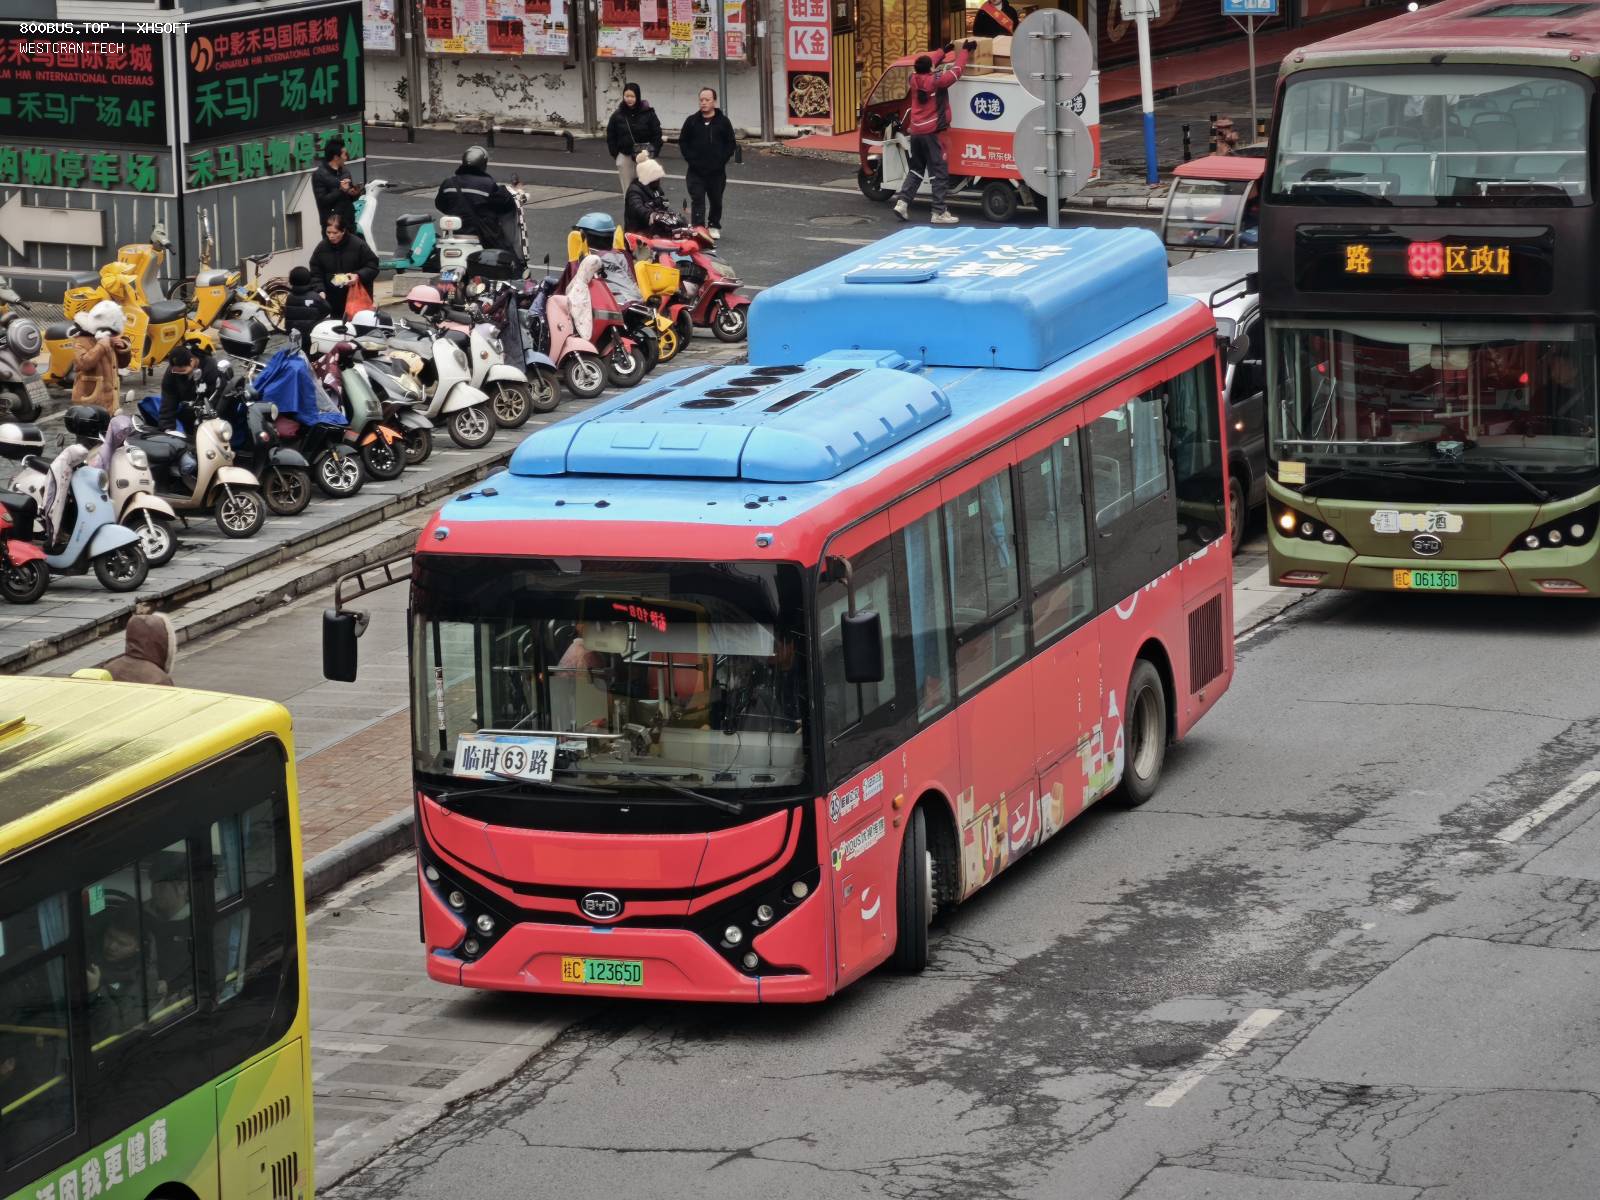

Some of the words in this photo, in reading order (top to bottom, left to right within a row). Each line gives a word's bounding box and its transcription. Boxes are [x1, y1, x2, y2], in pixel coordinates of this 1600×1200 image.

[214, 16, 339, 58] 中影禾马国际影城
[794, 29, 826, 55] K金
[0, 37, 153, 72] 禾马国际影城
[265, 48, 310, 63] INTERNATIONAL
[312, 43, 340, 56] CINEMAS
[15, 70, 32, 80] HM
[35, 70, 108, 84] INTERNATIONAL
[111, 74, 154, 87] CINEMAS
[974, 97, 1001, 115] 快递
[961, 143, 987, 159] JDL
[988, 151, 1016, 161] 京东快
[0, 146, 158, 192] 购物停车场
[1345, 244, 1372, 273] 路
[1408, 243, 1443, 276] 88
[585, 899, 616, 912] BYD
[589, 963, 641, 982] 12365D
